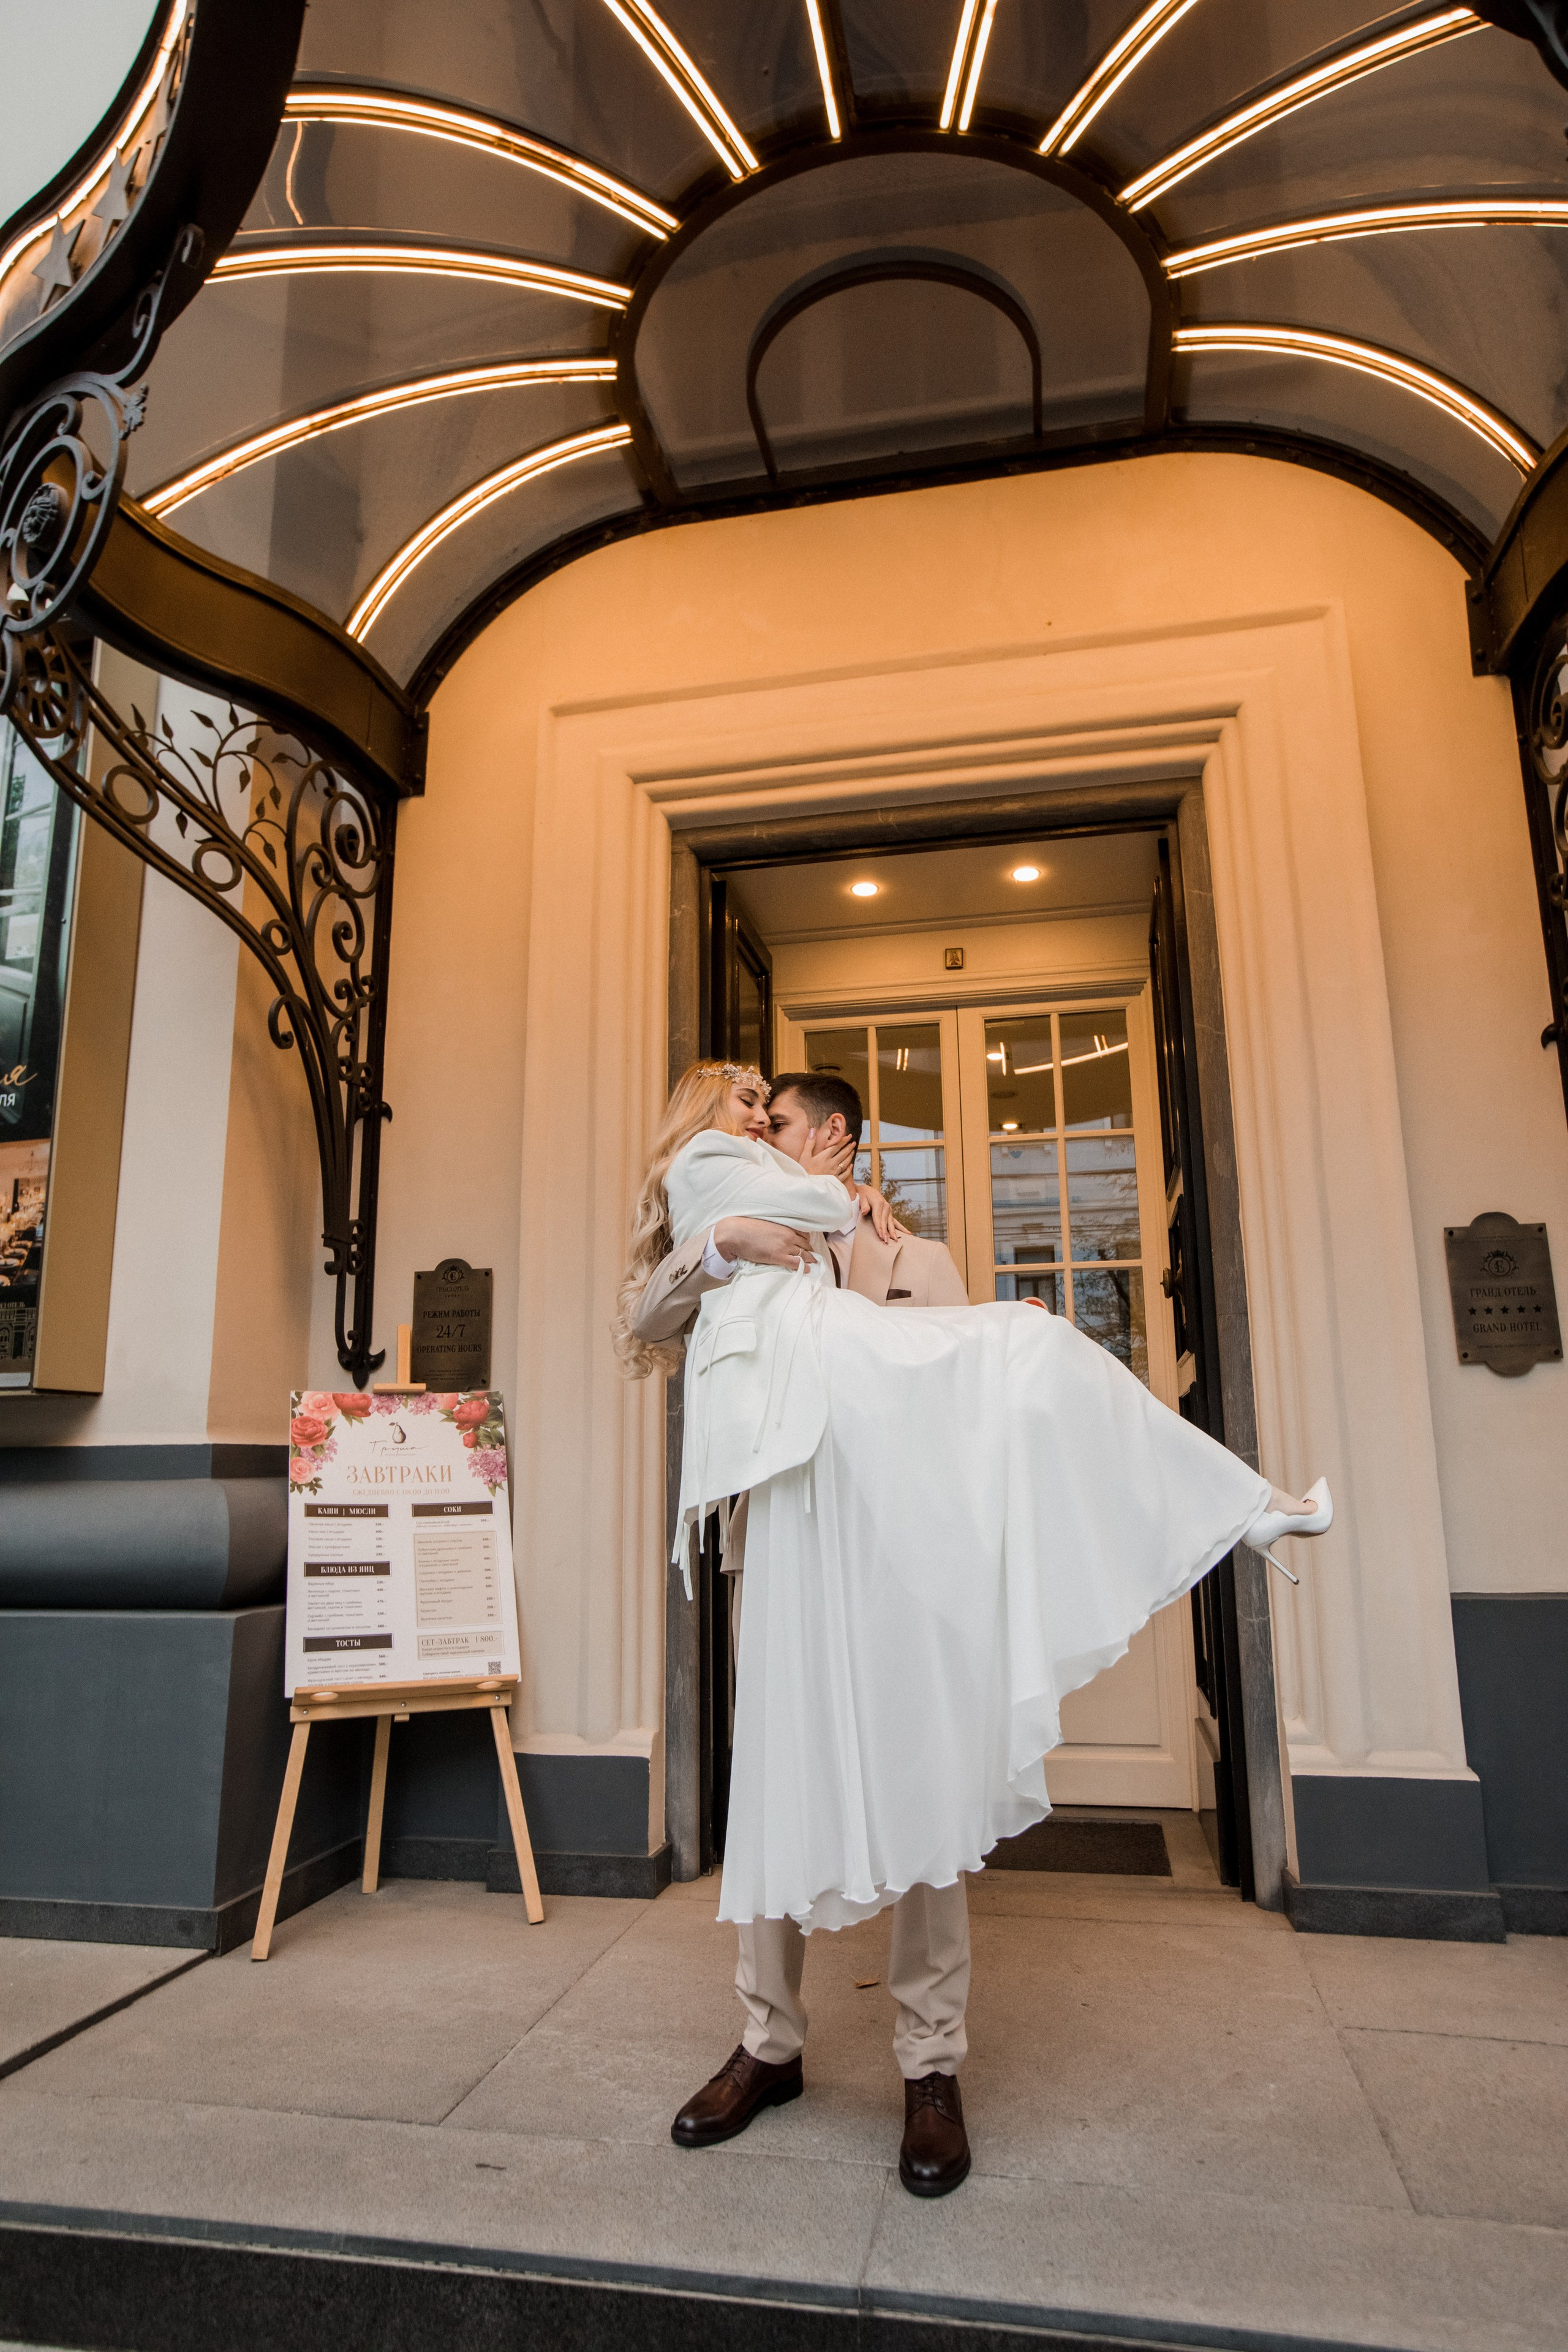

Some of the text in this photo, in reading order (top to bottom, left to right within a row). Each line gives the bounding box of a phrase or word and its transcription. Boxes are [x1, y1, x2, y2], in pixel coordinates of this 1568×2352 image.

[1470, 1286, 1536, 1297] ГРАНД ОТЕЛЬ
[436, 1324, 466, 1338] 24/7
[1473, 1322, 1542, 1333] GRAND HOTEL
[347, 1464, 452, 1483] ЗАВТРАКИ
[421, 1637, 469, 1646] СЕТ-ЗАВТРАК
